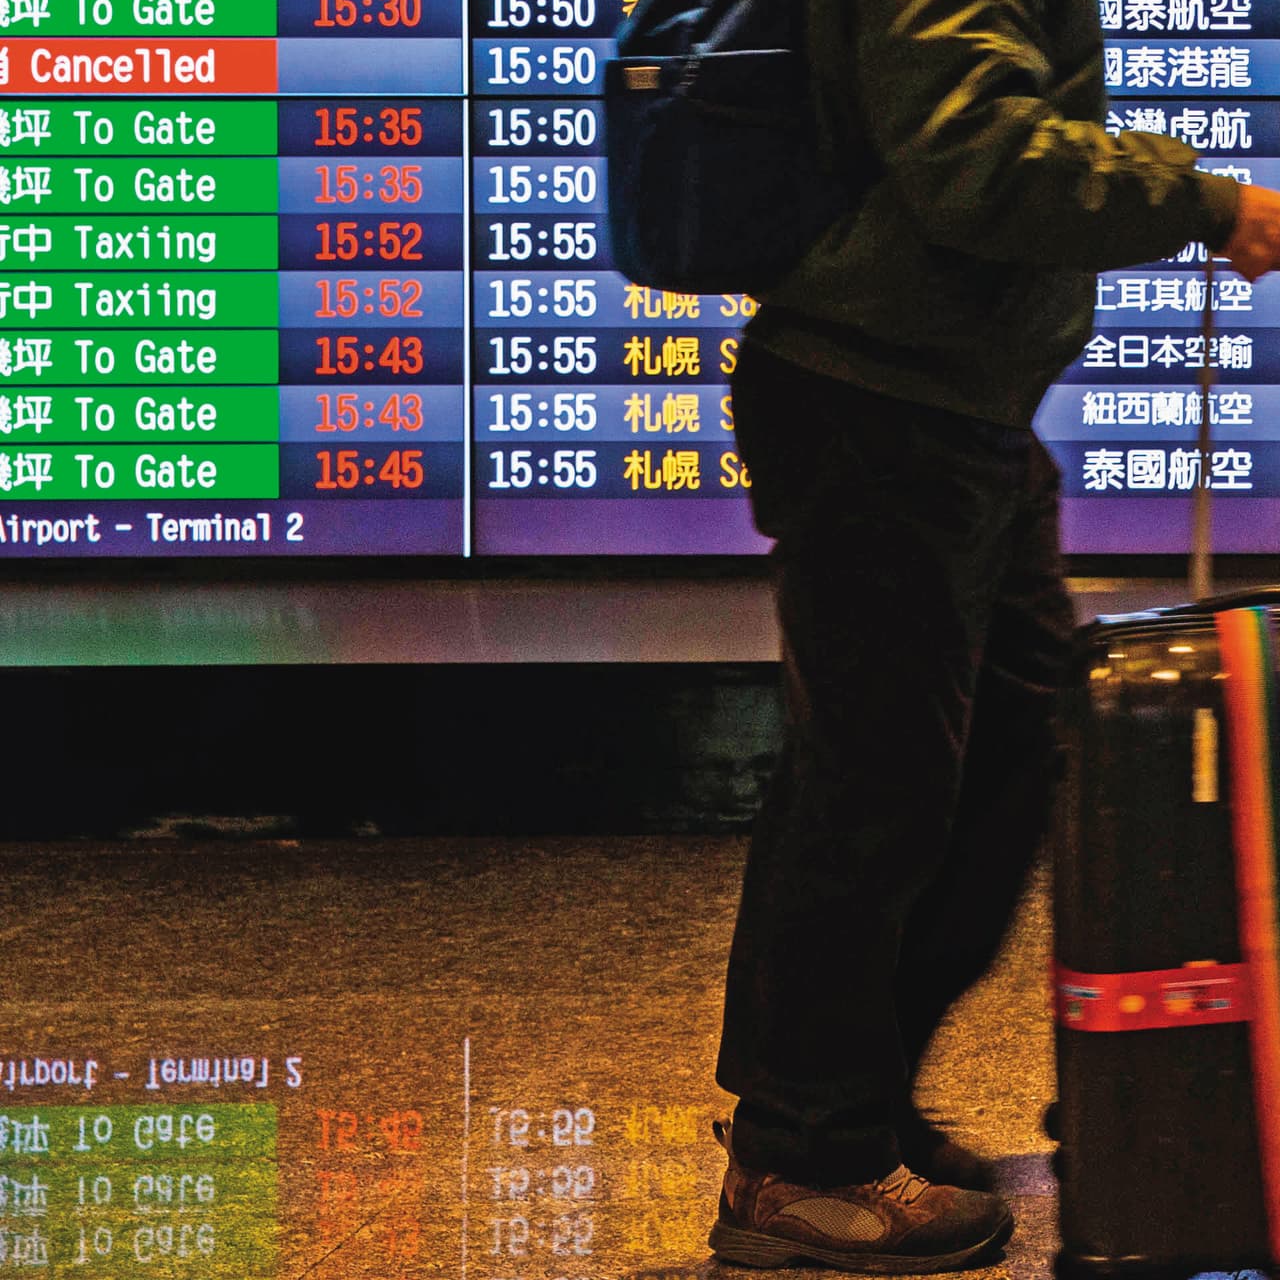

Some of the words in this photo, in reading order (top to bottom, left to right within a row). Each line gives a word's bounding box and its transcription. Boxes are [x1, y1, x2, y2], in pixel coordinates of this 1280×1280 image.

[31, 48, 215, 83] Cancelled
[74, 225, 216, 263] Taxiing
[315, 222, 423, 260] 15:52
[1082, 390, 1253, 426] 紐西蘭航空
[74, 454, 115, 489] To
[135, 454, 217, 488] Gate
[315, 450, 424, 489] 15:45
[489, 450, 597, 488] 15:55
[623, 449, 701, 491] 札幌
[1082, 447, 1253, 490] 泰國航空
[146, 512, 271, 542] Terminal
[286, 511, 305, 541] 2
